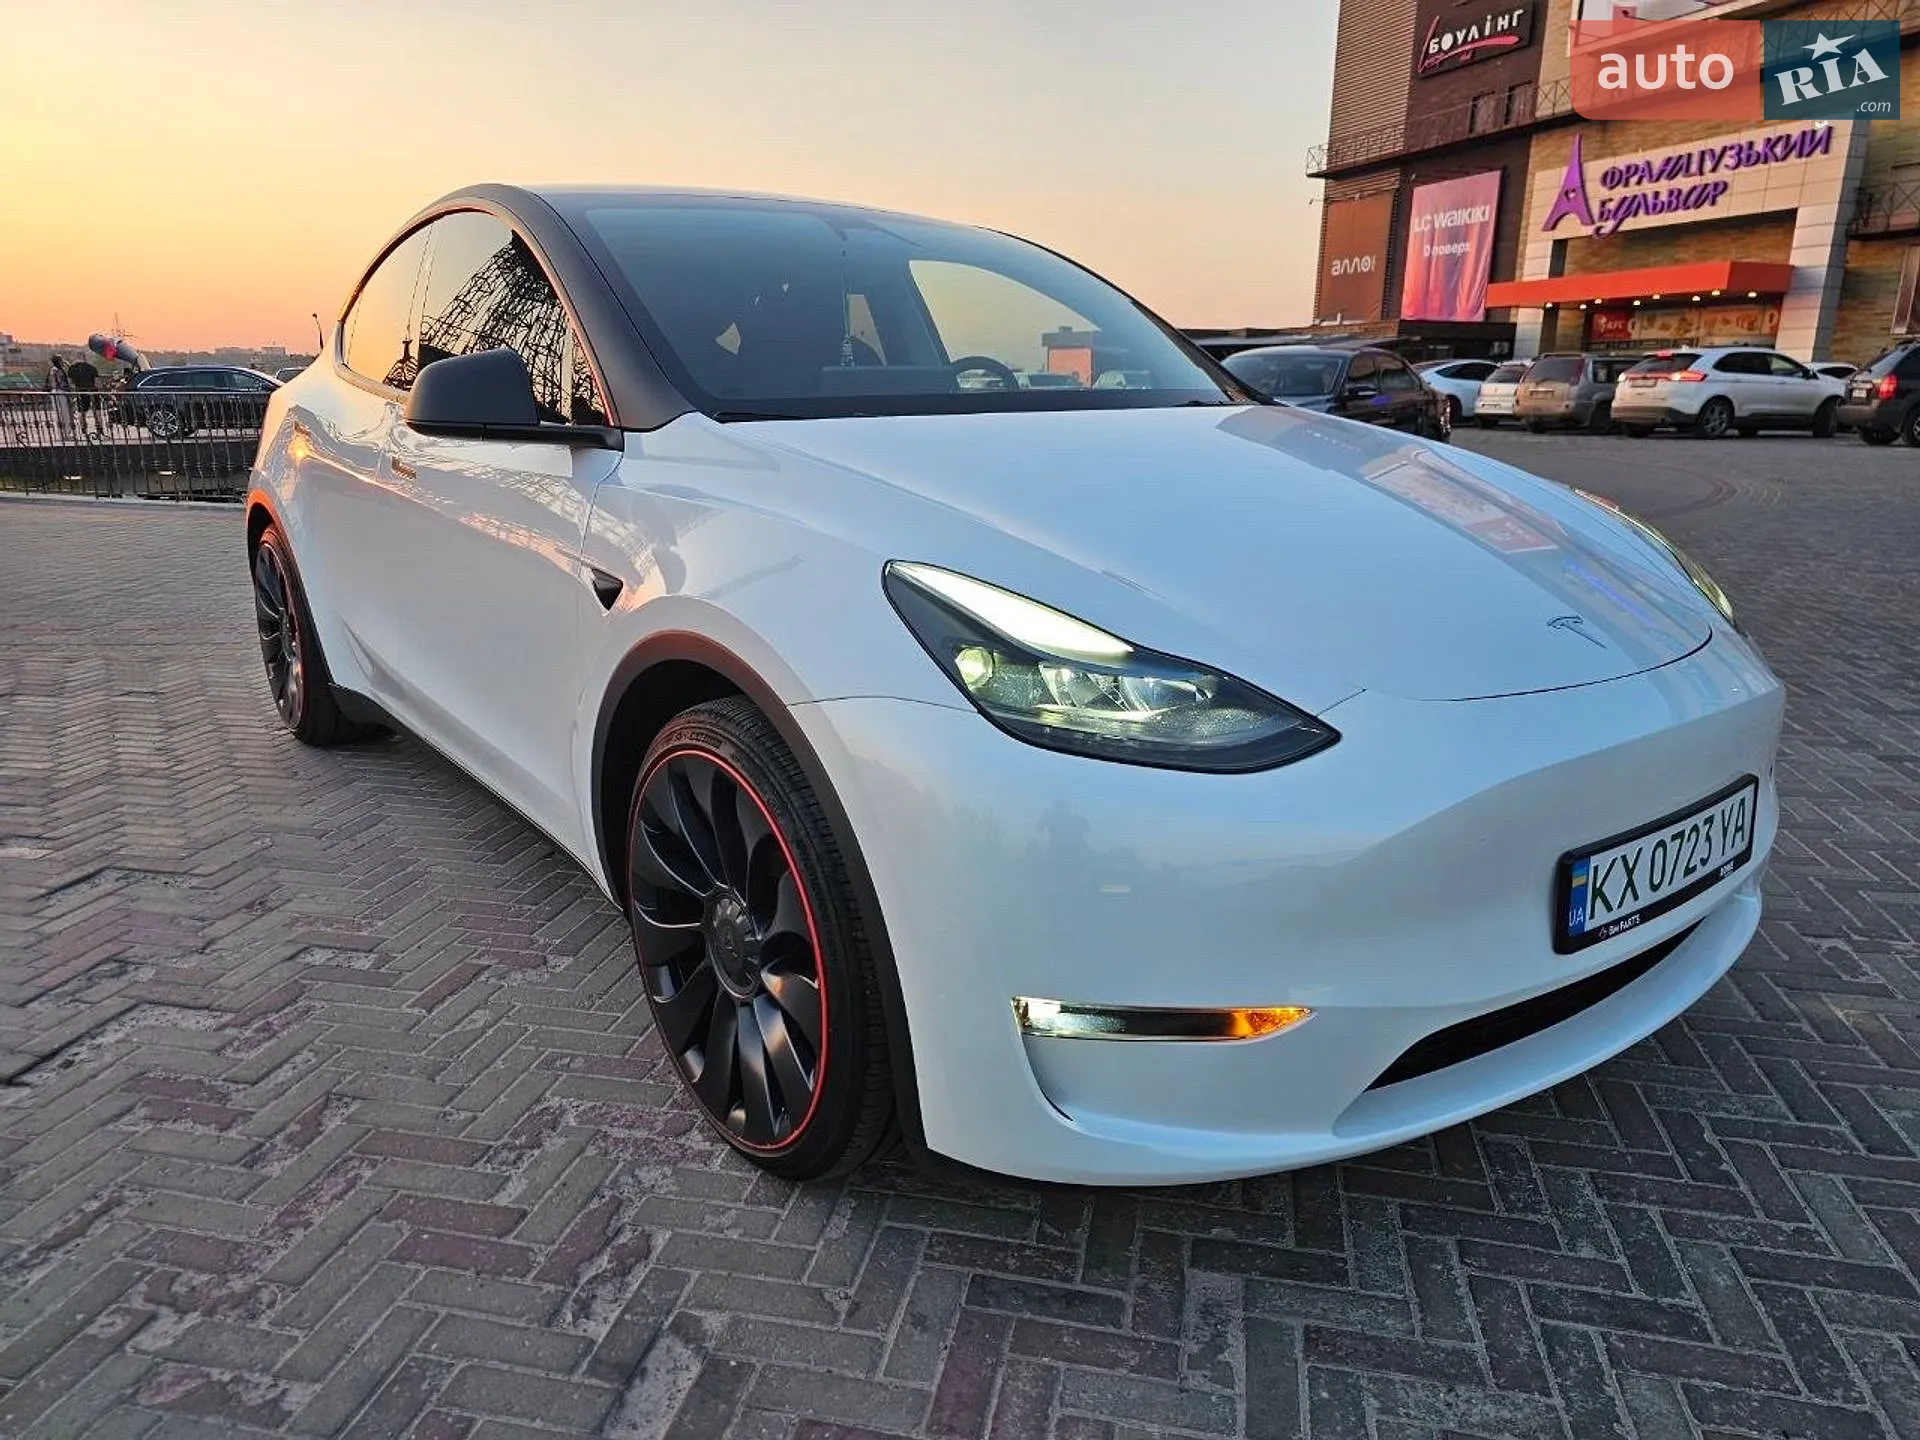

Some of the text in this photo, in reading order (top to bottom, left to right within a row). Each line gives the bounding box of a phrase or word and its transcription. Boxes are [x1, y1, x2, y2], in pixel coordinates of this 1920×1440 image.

[1601, 121, 1834, 190] ФРАНЦУЗЬКИЙ
[1414, 214, 1432, 232] LC
[1588, 796, 1746, 920] KX 0723 YA
[1568, 907, 1584, 927] UA
